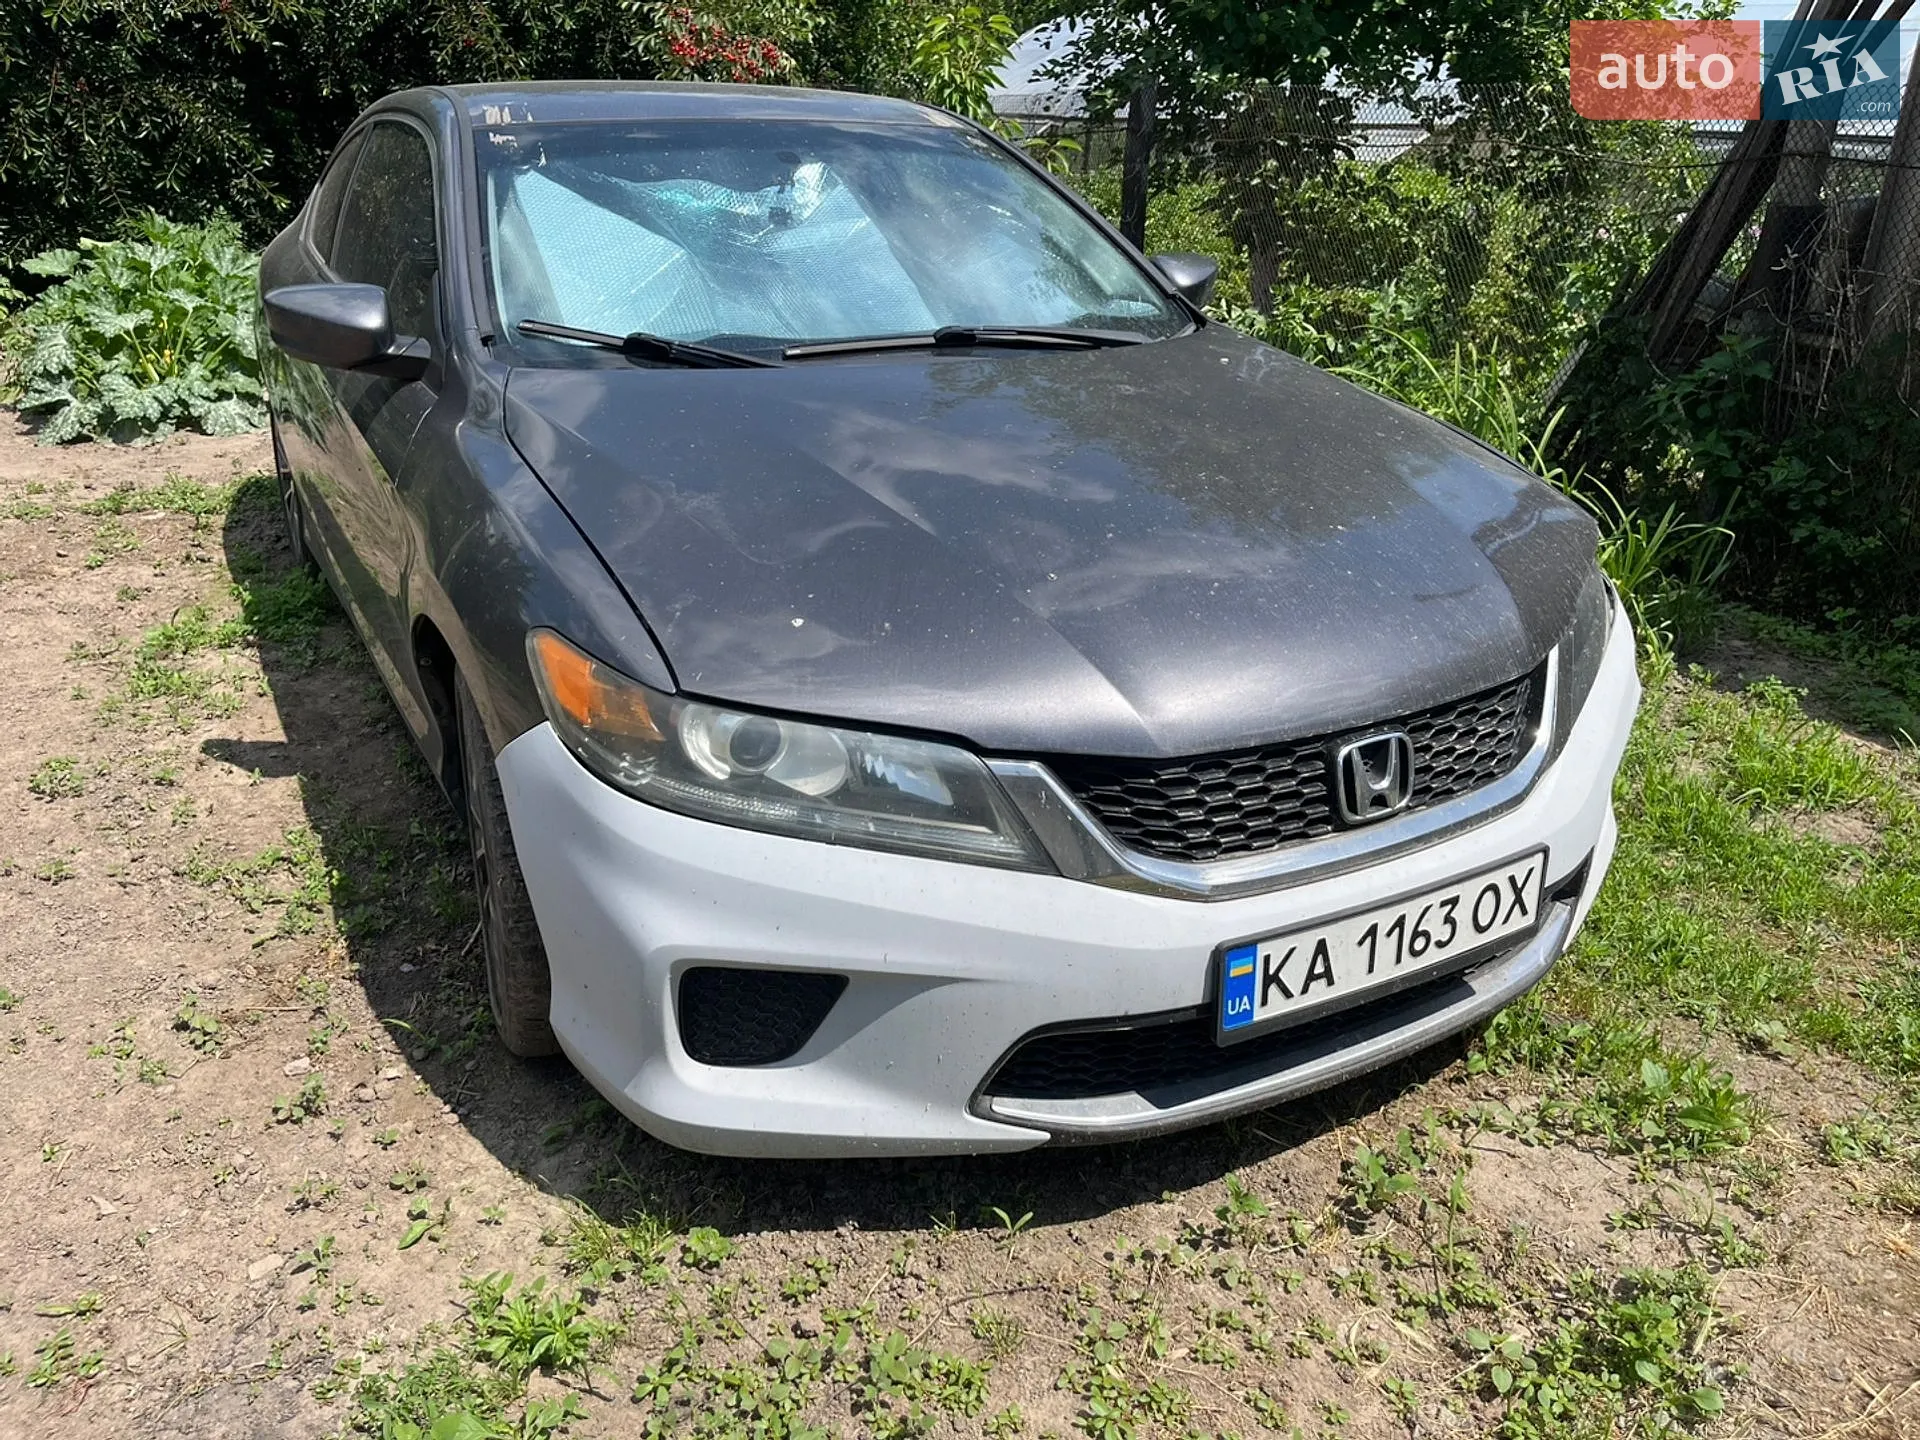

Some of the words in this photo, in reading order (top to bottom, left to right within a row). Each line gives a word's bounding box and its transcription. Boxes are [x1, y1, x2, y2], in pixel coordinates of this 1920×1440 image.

[1260, 938, 1335, 1006] KA
[1357, 895, 1460, 975] 1163
[1472, 867, 1535, 933] OX
[1227, 995, 1251, 1016] UA
